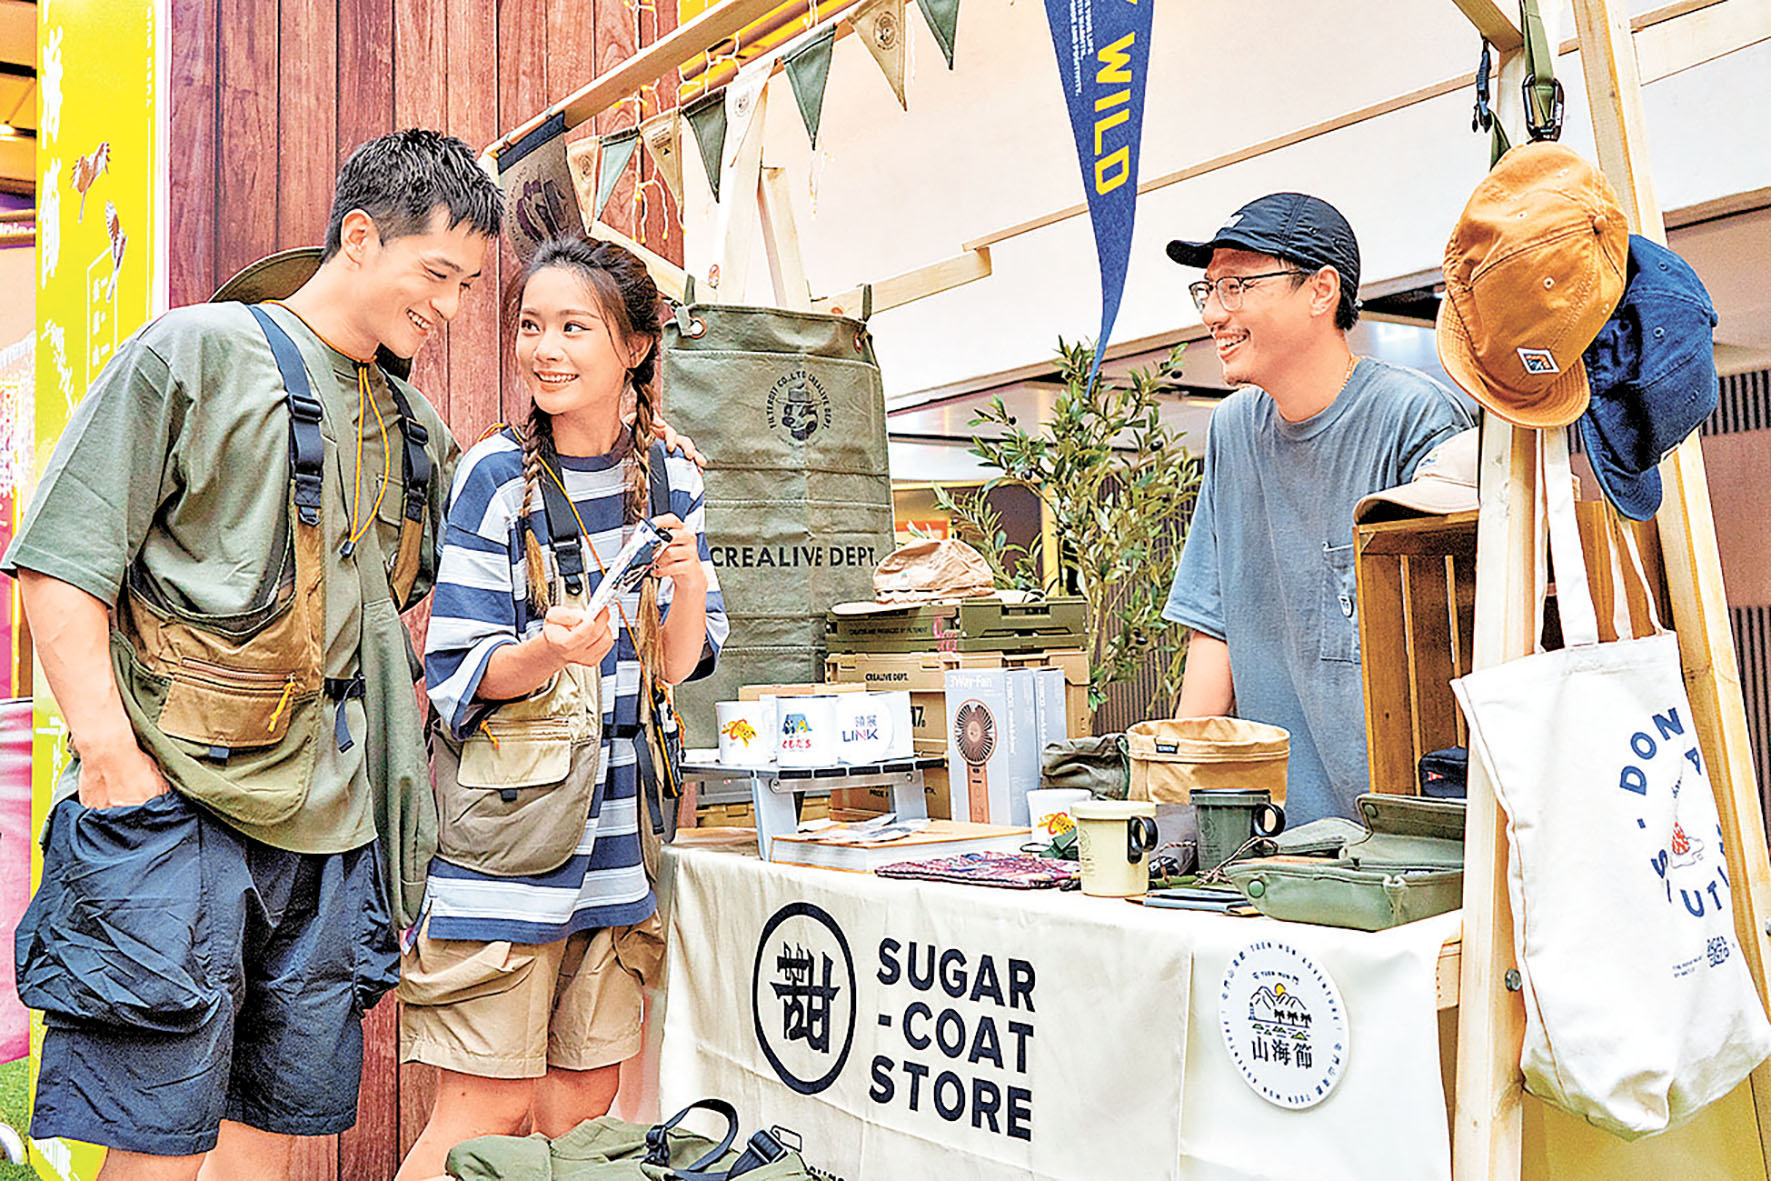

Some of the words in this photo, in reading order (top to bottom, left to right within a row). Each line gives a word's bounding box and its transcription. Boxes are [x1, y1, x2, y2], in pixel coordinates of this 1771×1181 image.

[1094, 31, 1136, 196] WILD
[709, 546, 822, 568] CREALIVE
[829, 547, 879, 567] DEPT.
[842, 729, 879, 743] LINK
[876, 937, 1036, 1013] SUGAR
[1251, 1035, 1313, 1070] 山海節
[868, 1054, 1032, 1143] STORE
